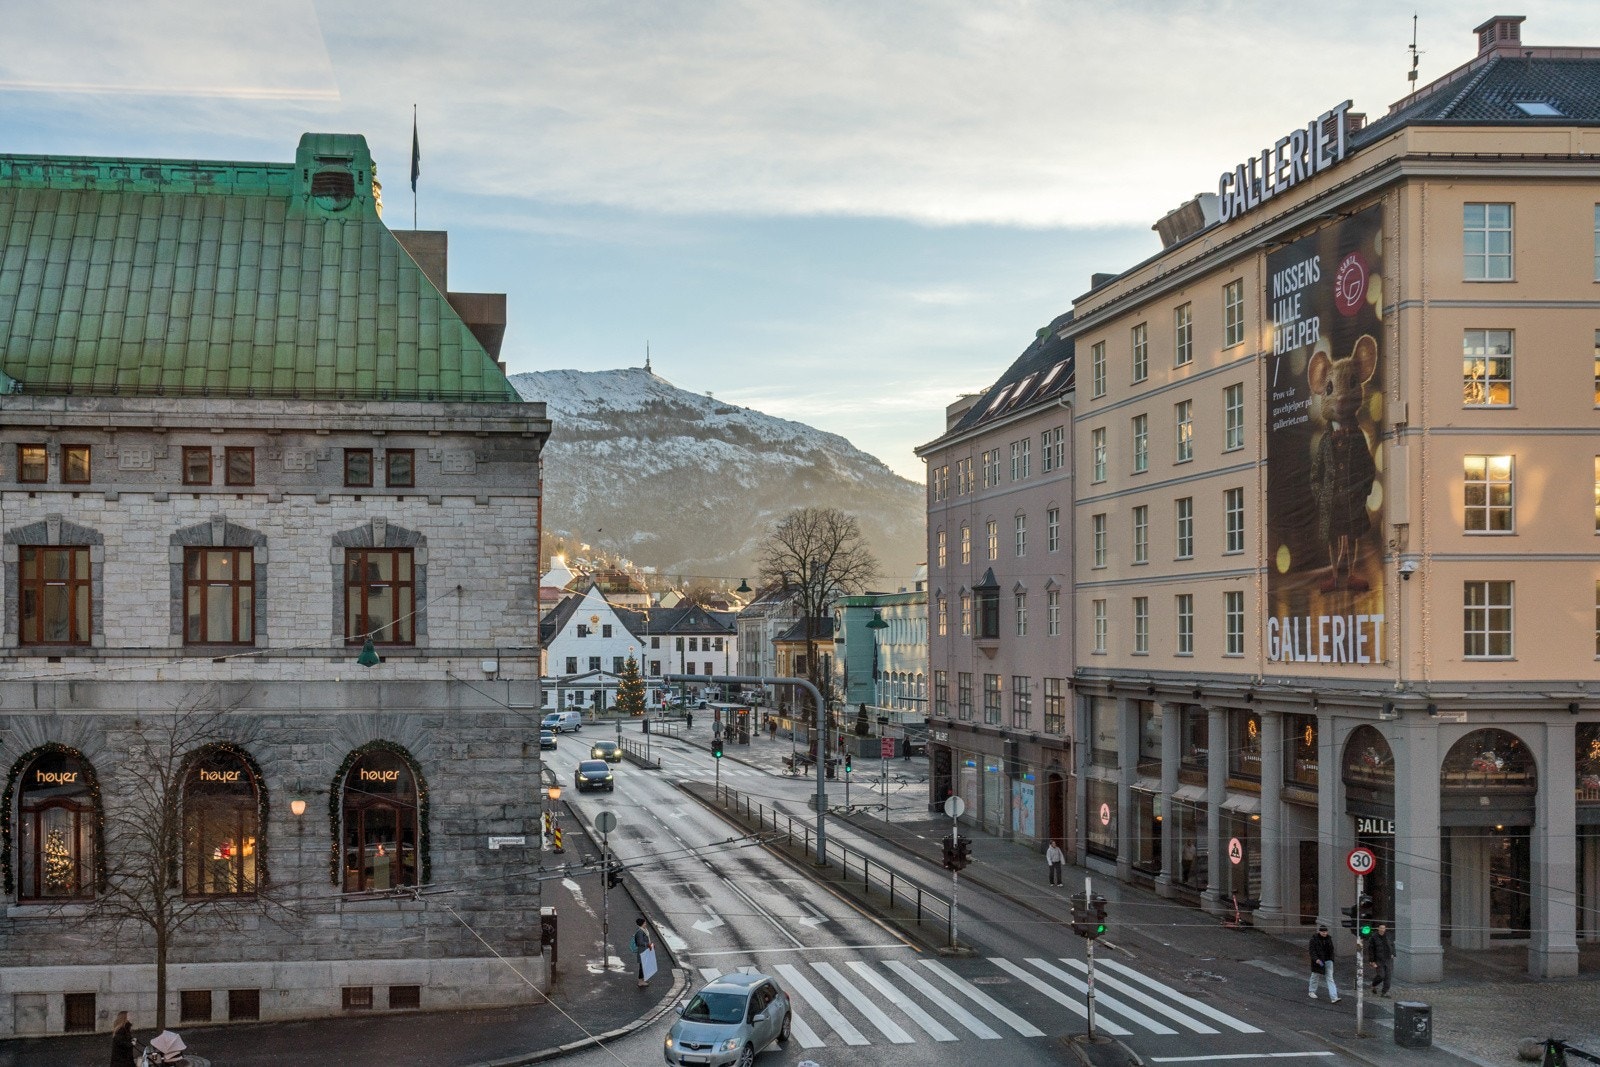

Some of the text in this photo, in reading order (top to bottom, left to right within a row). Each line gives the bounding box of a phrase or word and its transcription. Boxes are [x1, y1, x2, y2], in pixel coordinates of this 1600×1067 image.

[1218, 99, 1353, 223] GALLERIET
[1273, 255, 1321, 299] NISSENS
[1335, 274, 1343, 298] BEAR
[1273, 293, 1302, 327] LILLE
[1273, 316, 1321, 356] HJELPER
[1267, 613, 1385, 664] GALLERIET
[37, 769, 78, 785] høyer
[200, 768, 240, 783] høyer
[360, 768, 400, 783] høyer
[1352, 854, 1371, 868] 30
